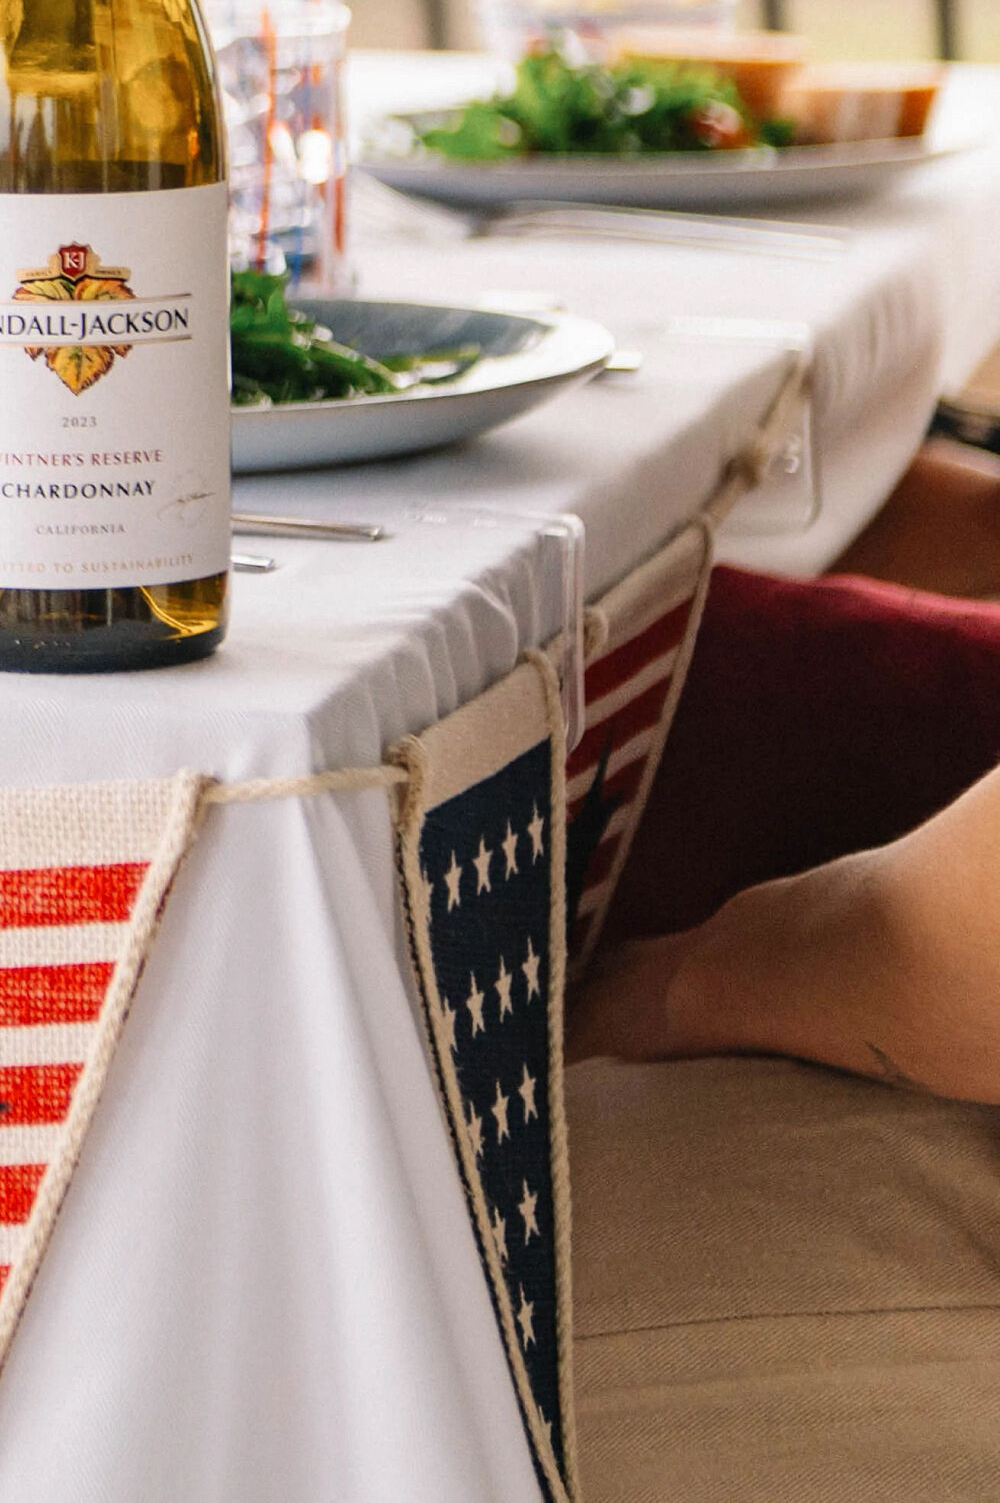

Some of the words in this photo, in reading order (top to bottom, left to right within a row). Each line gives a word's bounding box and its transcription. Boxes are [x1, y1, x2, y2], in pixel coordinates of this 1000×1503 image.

[62, 416, 98, 428] 2023
[91, 449, 163, 466] RESERVE
[1, 480, 155, 499] CHARDONNAY
[36, 524, 127, 536] CALIFORNIA
[54, 563, 74, 574] TO
[82, 553, 194, 573] SUSTAINABILITY
